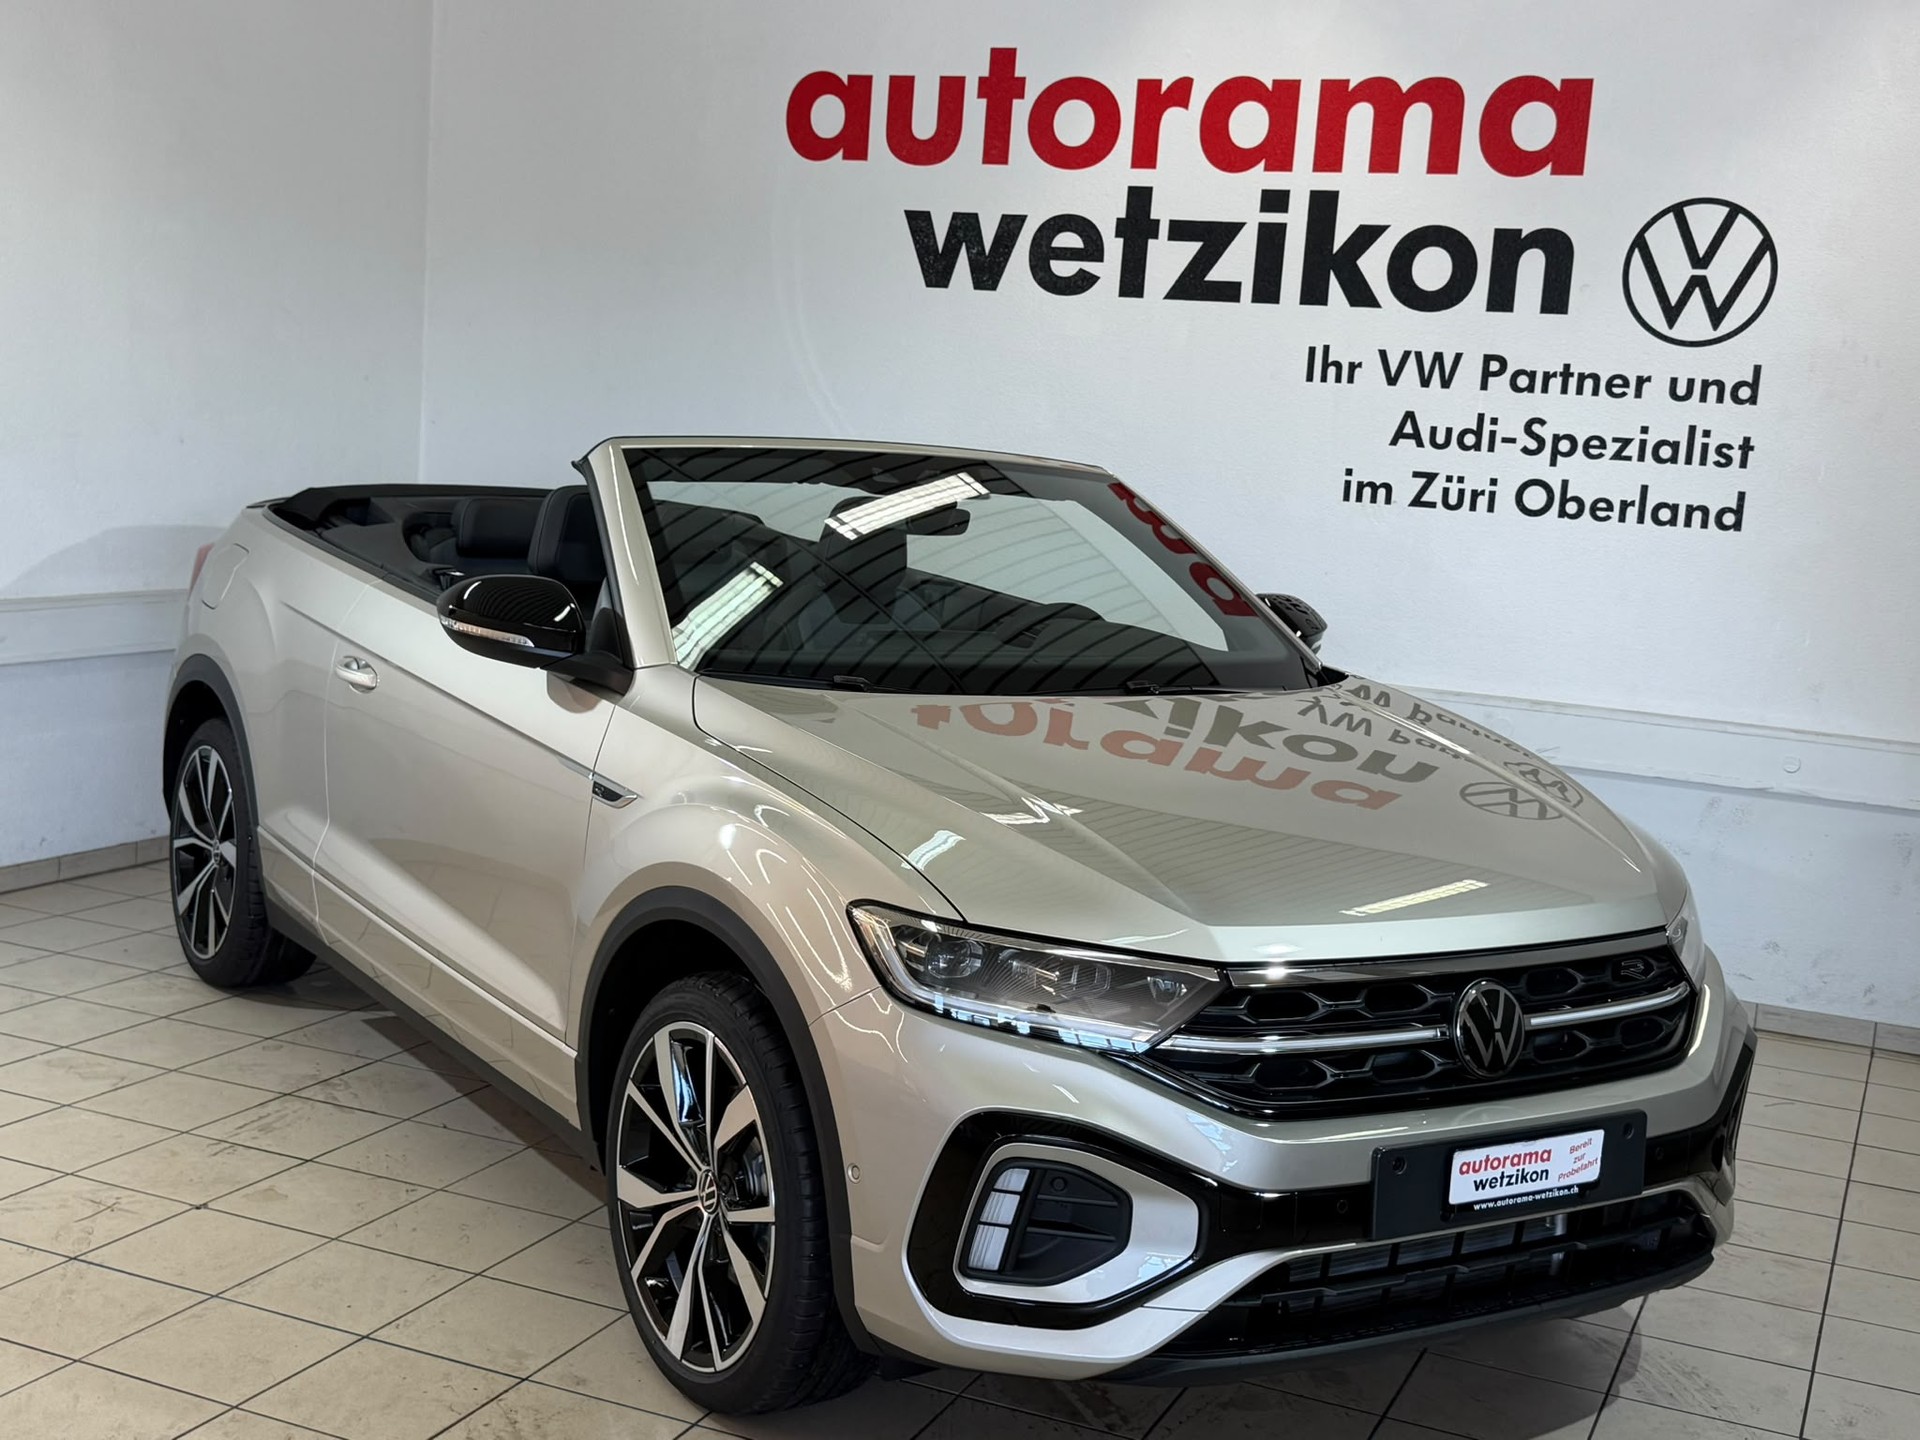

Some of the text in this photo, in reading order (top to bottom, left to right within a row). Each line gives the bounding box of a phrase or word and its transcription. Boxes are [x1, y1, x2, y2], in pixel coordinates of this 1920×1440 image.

[786, 47, 1593, 177] autorama
[904, 186, 1574, 314] wetzikon
[1306, 345, 1761, 405] Ihr VW Partner und
[1389, 411, 1754, 469] Audi-Spezialist
[1342, 468, 1745, 532] im Züri Oberland
[1569, 1137, 1592, 1154] Bereit
[1573, 1152, 1586, 1164] zur
[1459, 1148, 1552, 1176] autorama
[1557, 1157, 1598, 1182] Probefahrt
[1473, 1167, 1550, 1192] wetzikon
[1473, 1185, 1579, 1211] www.autorama-wetzikon.ch
